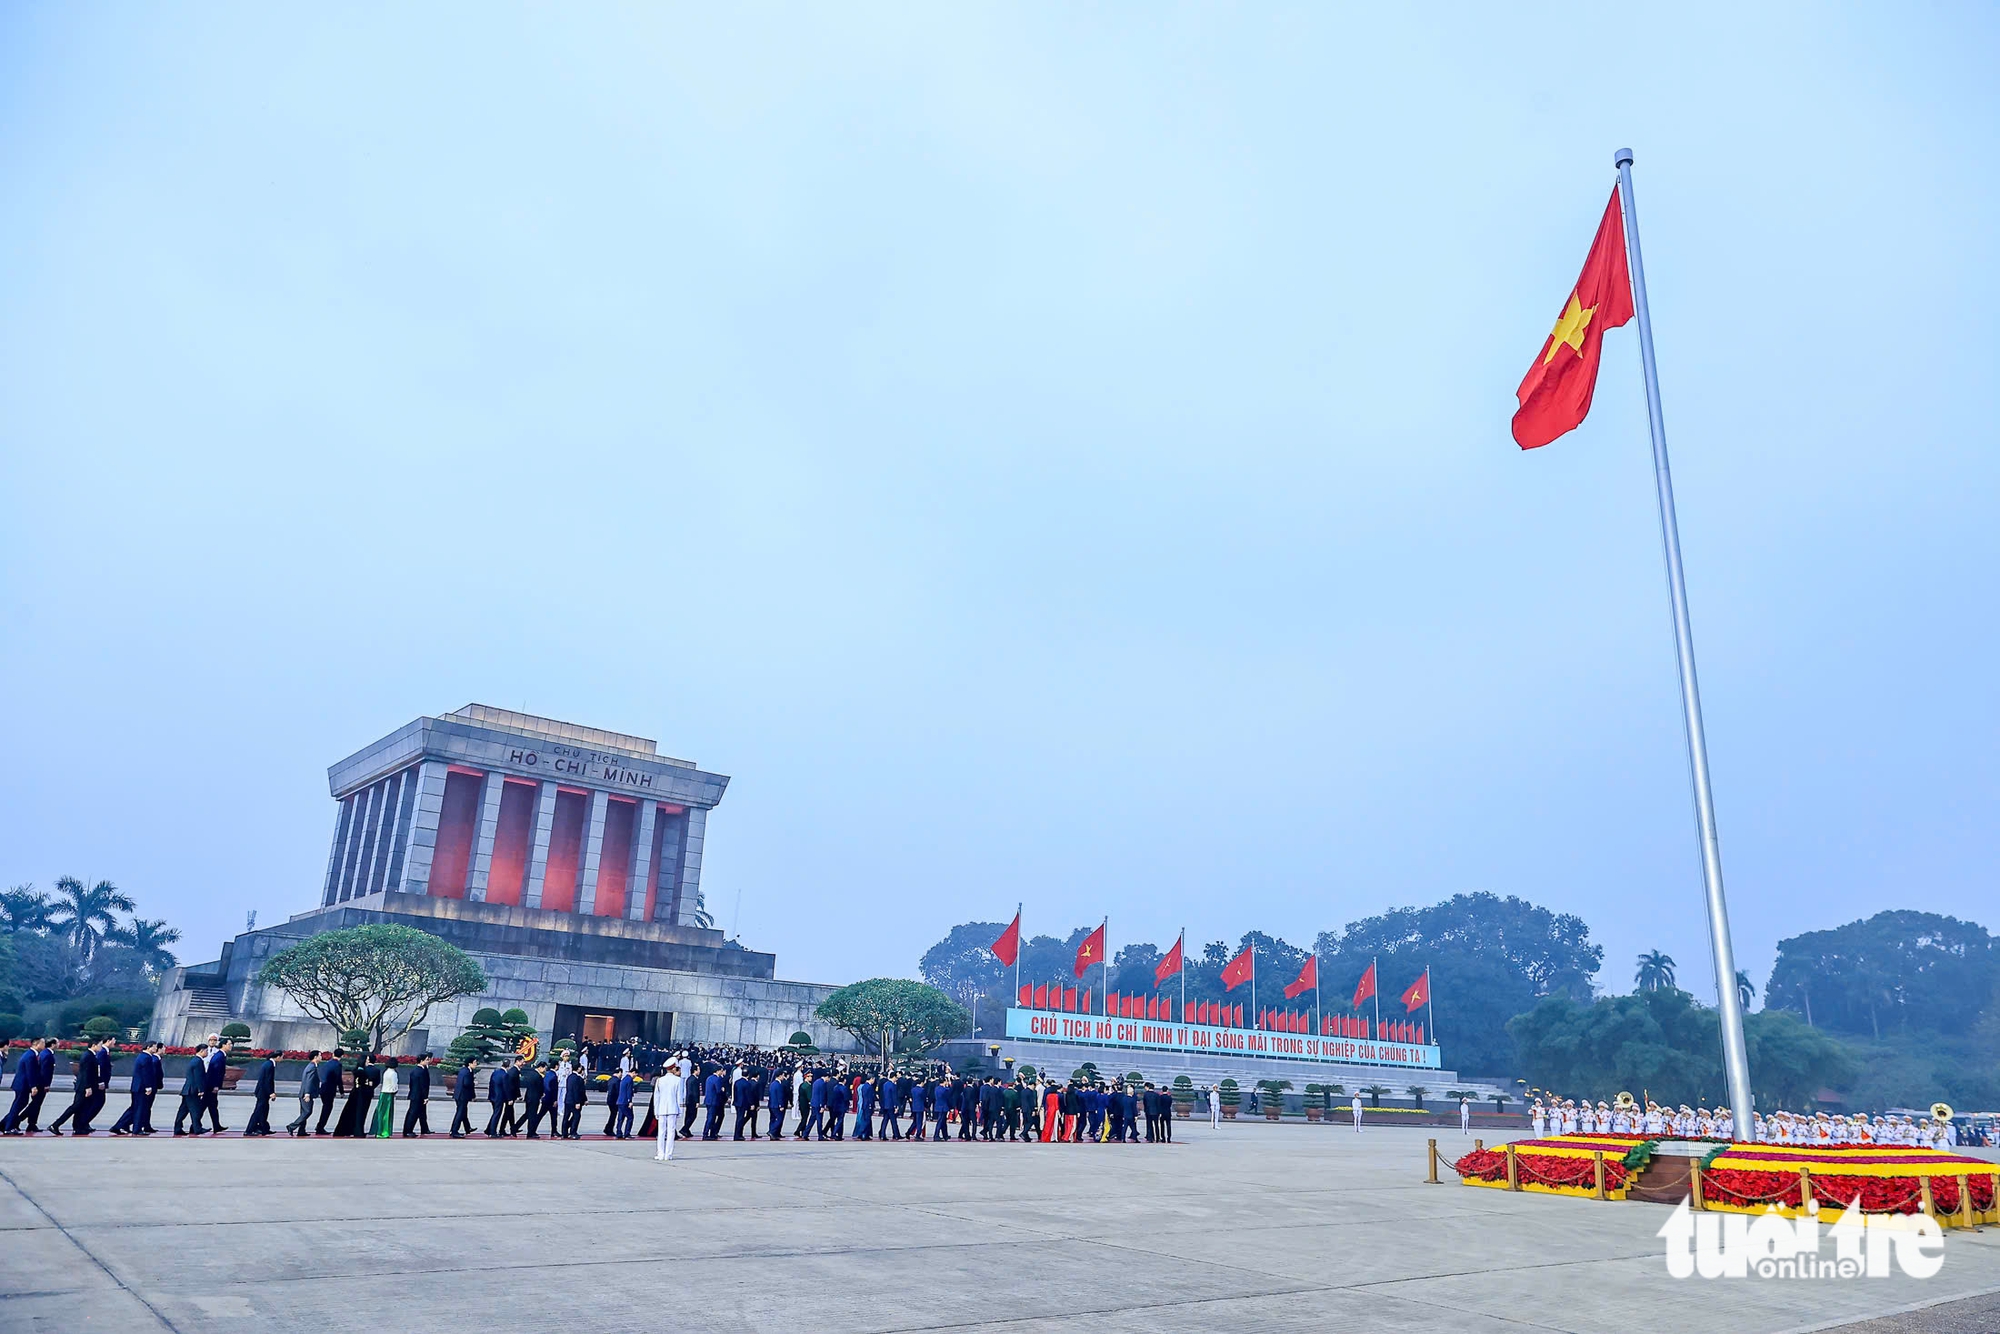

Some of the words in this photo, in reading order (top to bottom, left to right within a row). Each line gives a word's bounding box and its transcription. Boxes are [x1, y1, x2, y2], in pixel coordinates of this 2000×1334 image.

[1031, 1012, 1057, 1035] CHỦ
[1063, 1019, 1091, 1040] TỊCH
[1096, 1016, 1112, 1040] HỒ
[1117, 1021, 1137, 1042] CHÍ
[1142, 1025, 1172, 1045] MINH
[1177, 1026, 1189, 1046] VĨ
[1192, 1030, 1211, 1050] ĐẠI
[1215, 1028, 1244, 1050] SỐNG
[1248, 1032, 1267, 1052] MÃI
[1271, 1036, 1303, 1054] TRONG
[1306, 1038, 1320, 1058] SỰ
[1322, 1039, 1356, 1060] NGHIỆP
[1358, 1040, 1376, 1060] CỦA
[1379, 1043, 1407, 1062] CHÚNG
[1410, 1048, 1421, 1063] TA
